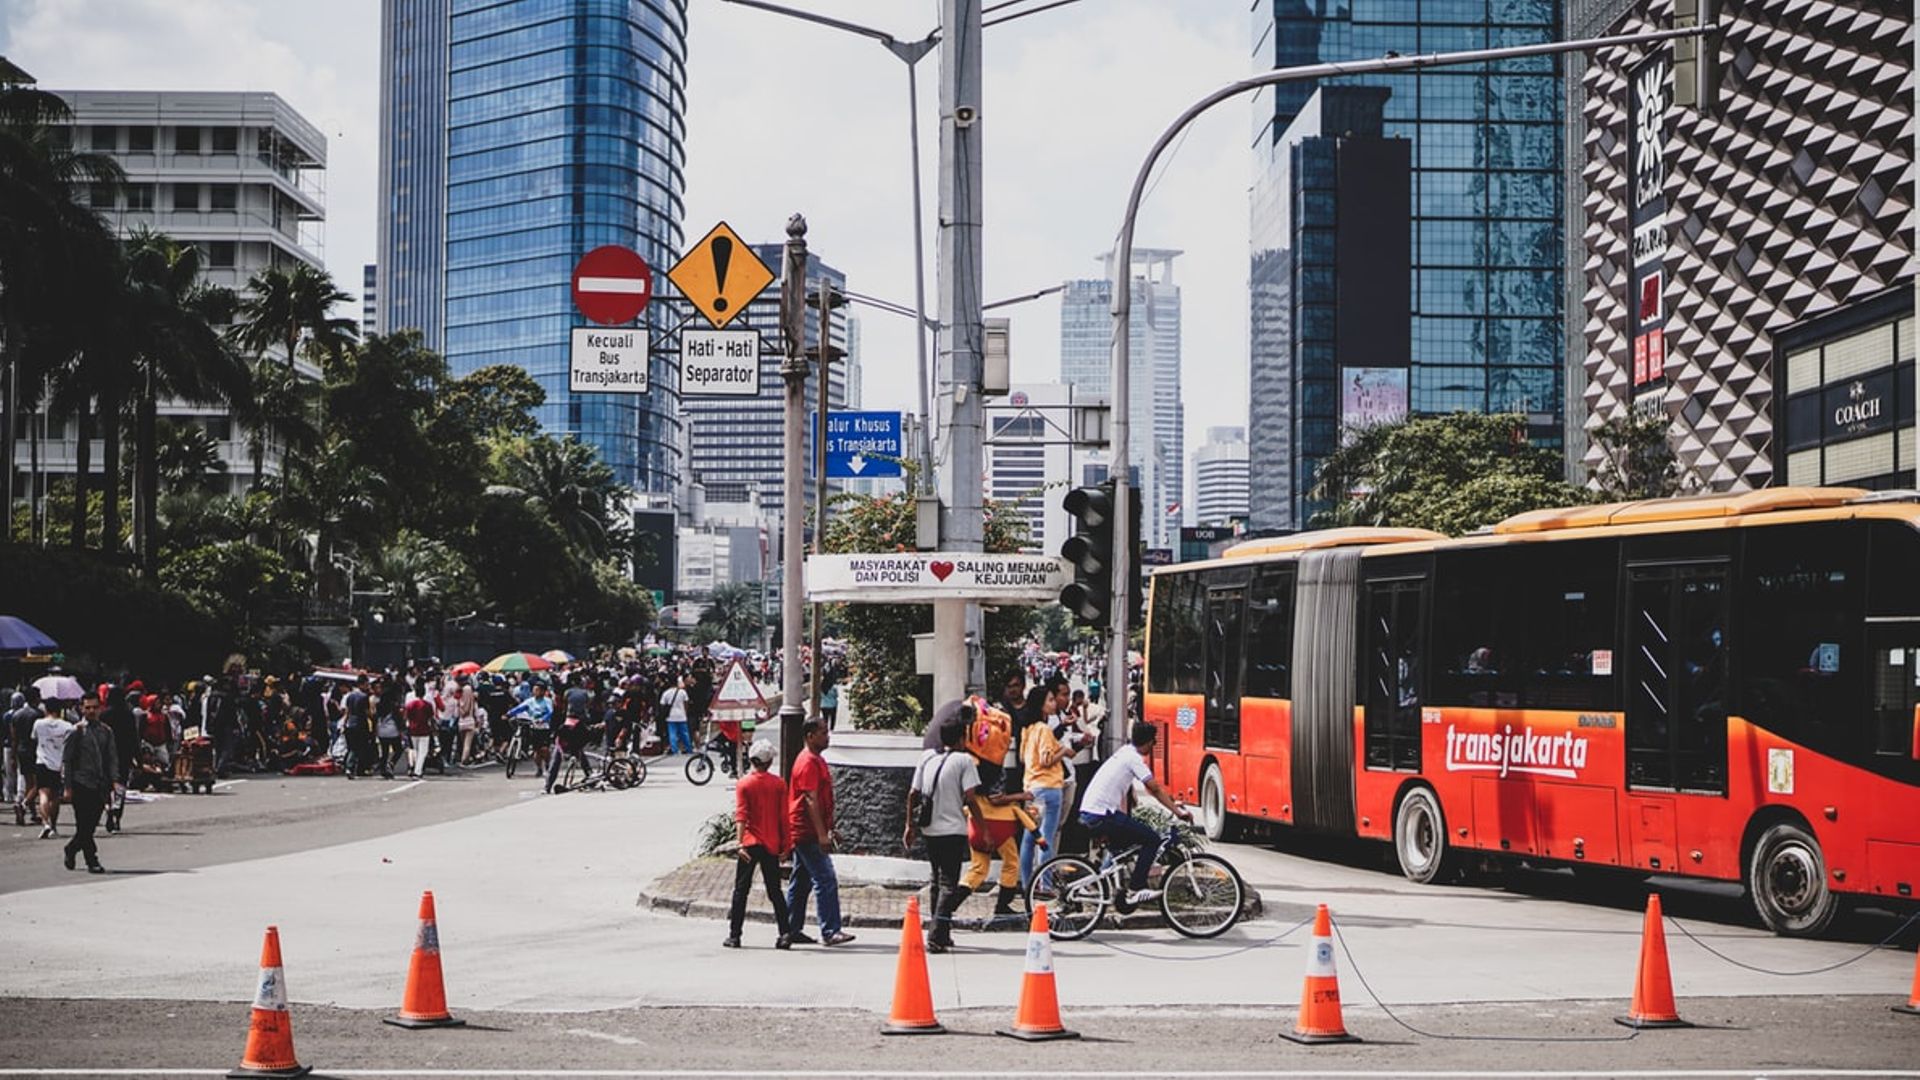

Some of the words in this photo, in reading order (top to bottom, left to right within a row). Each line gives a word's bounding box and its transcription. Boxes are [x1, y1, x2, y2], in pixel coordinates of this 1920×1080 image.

[587, 334, 634, 348] Kecuali
[688, 339, 714, 356] Hati
[726, 340, 752, 357] Hati
[599, 351, 621, 364] Bus
[573, 369, 646, 387] Transjakarta
[686, 364, 753, 386] Separator
[1835, 398, 1880, 425] COACH
[828, 418, 849, 432] alur
[854, 417, 891, 432] Khusus
[838, 437, 897, 453] Transjakarta
[1195, 530, 1215, 539] UOB
[850, 559, 927, 571] MASYARAKAT
[957, 561, 1004, 573] SALING
[1007, 562, 1061, 573] MENJAGA
[855, 571, 878, 582] DAN
[881, 571, 920, 583] POLISI
[975, 574, 1046, 585] KEJUJURAN
[1446, 724, 1588, 778] transjakarta
